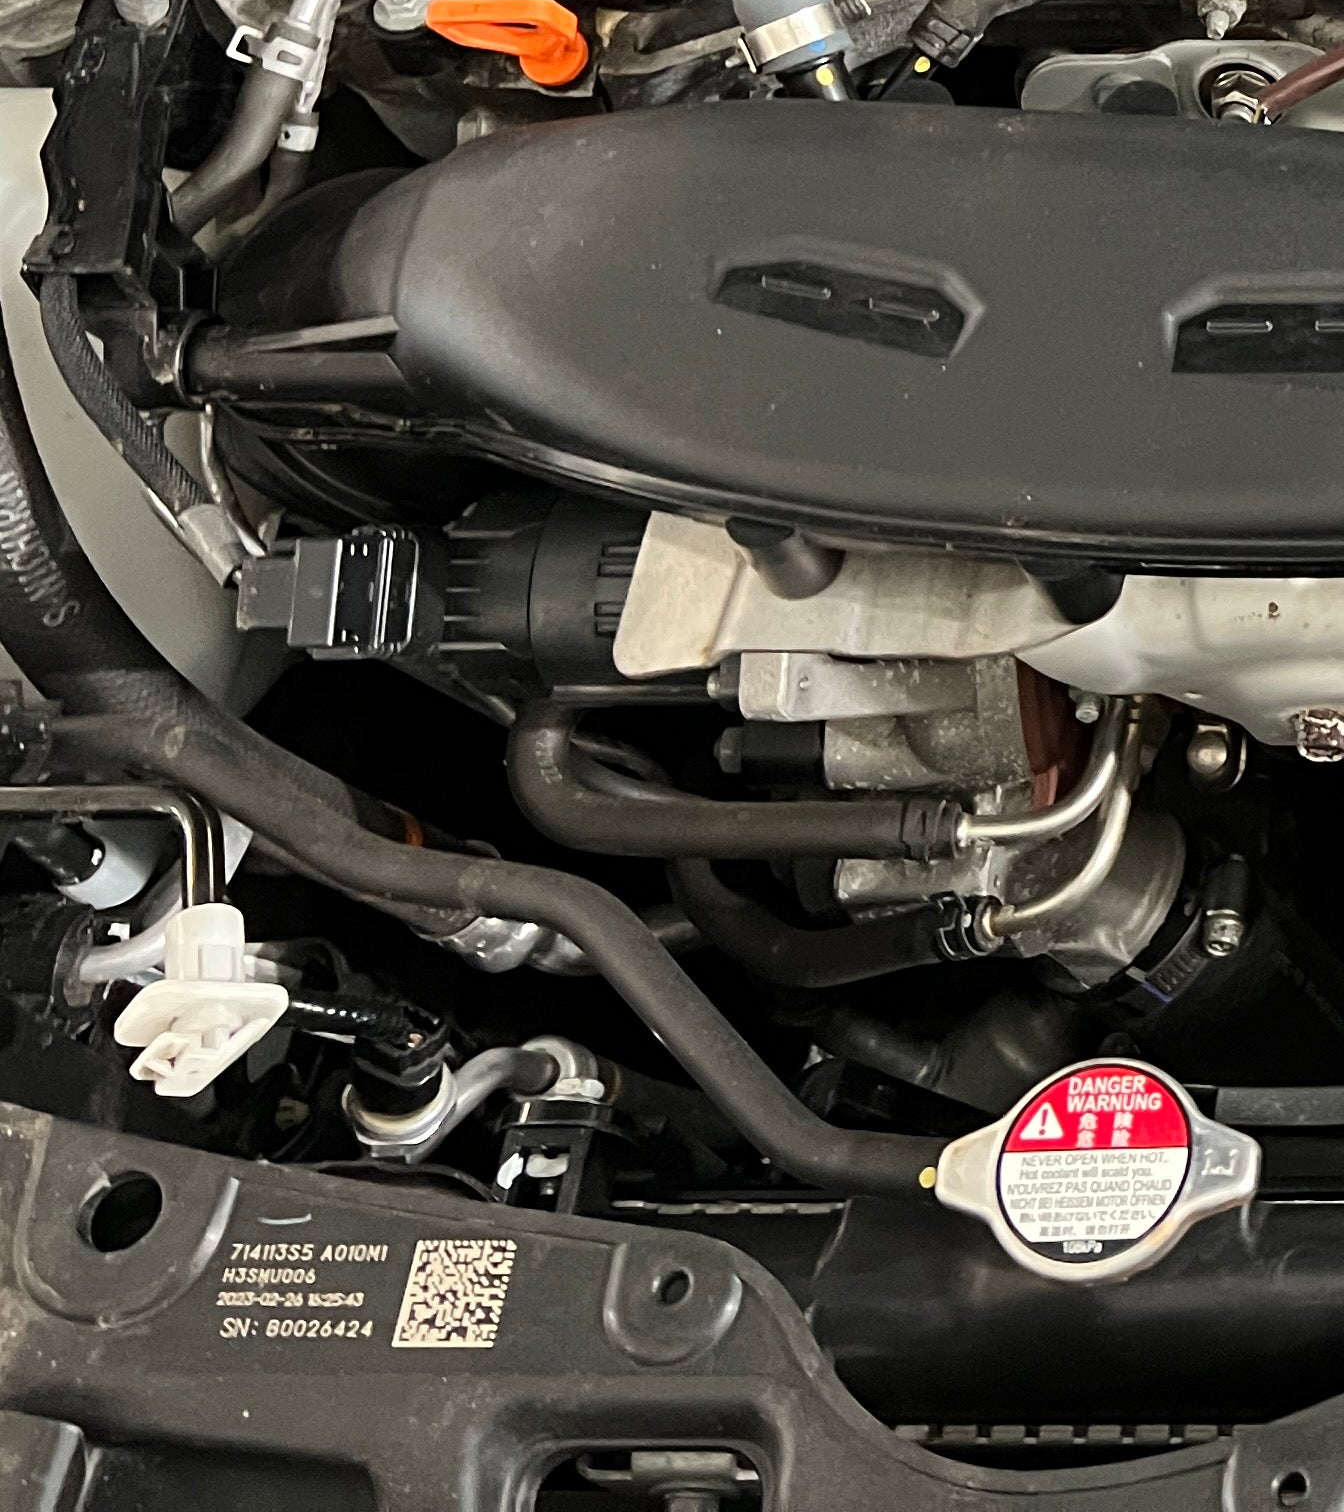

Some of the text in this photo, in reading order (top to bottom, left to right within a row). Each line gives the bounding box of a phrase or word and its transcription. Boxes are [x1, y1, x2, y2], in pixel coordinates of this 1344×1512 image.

[1068, 1074, 1147, 1095] DANGER
[1067, 1091, 1163, 1113] WARNUNG
[1021, 1154, 1062, 1167] NEVER
[1064, 1153, 1099, 1166] OPEN
[1101, 1152, 1138, 1165] WHEN
[1019, 1168, 1039, 1181] Hot
[1041, 1168, 1079, 1180] coolant
[1081, 1166, 1099, 1178] will
[1101, 1165, 1130, 1178] scald
[1064, 1180, 1089, 1194] PAS
[1090, 1179, 1131, 1193] QUAND
[1133, 1178, 1173, 1192] CHAUD
[1095, 1194, 1129, 1207] MOTOR
[216, 1291, 304, 1307] 2023-02-26
[219, 1317, 259, 1338] SN:
